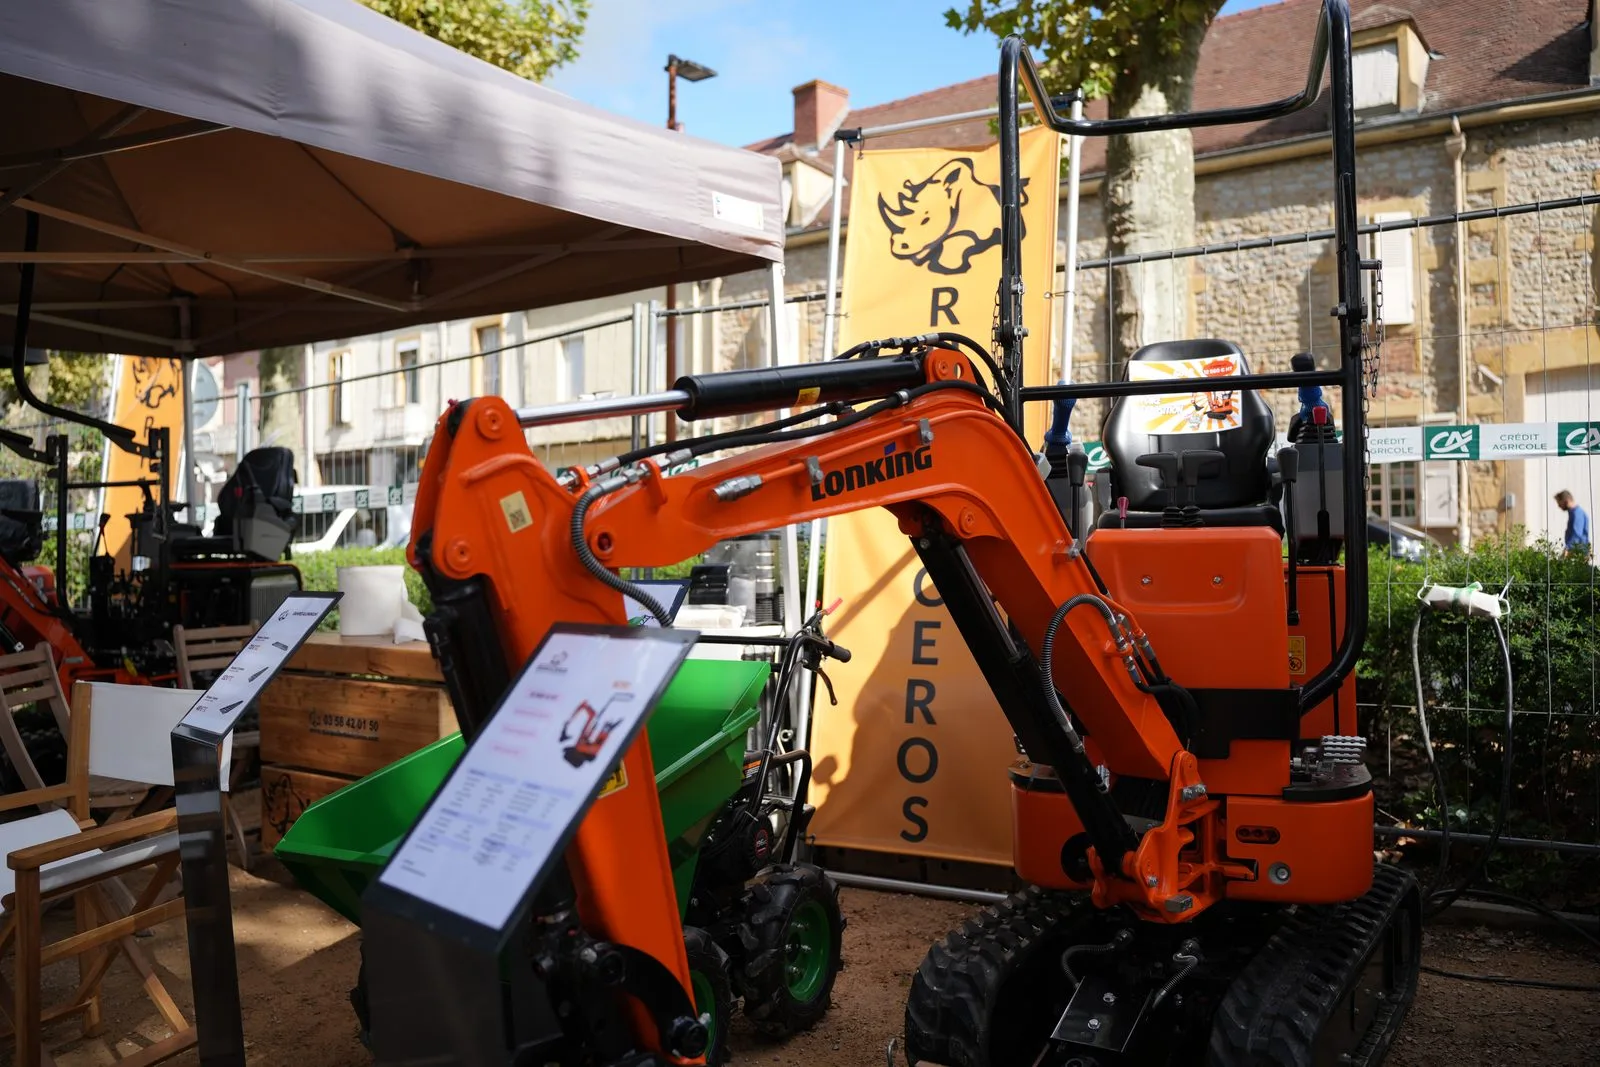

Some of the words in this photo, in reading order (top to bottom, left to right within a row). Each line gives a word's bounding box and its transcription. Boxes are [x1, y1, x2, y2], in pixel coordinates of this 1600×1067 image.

[1500, 433, 1540, 441] CRÉDIT
[1370, 446, 1414, 454] GRICOLE
[1492, 443, 1548, 451] AGRICOLE
[323, 715, 333, 726] 03
[345, 718, 355, 729] 42
[357, 719, 366, 730] 01
[369, 720, 379, 732] 50
